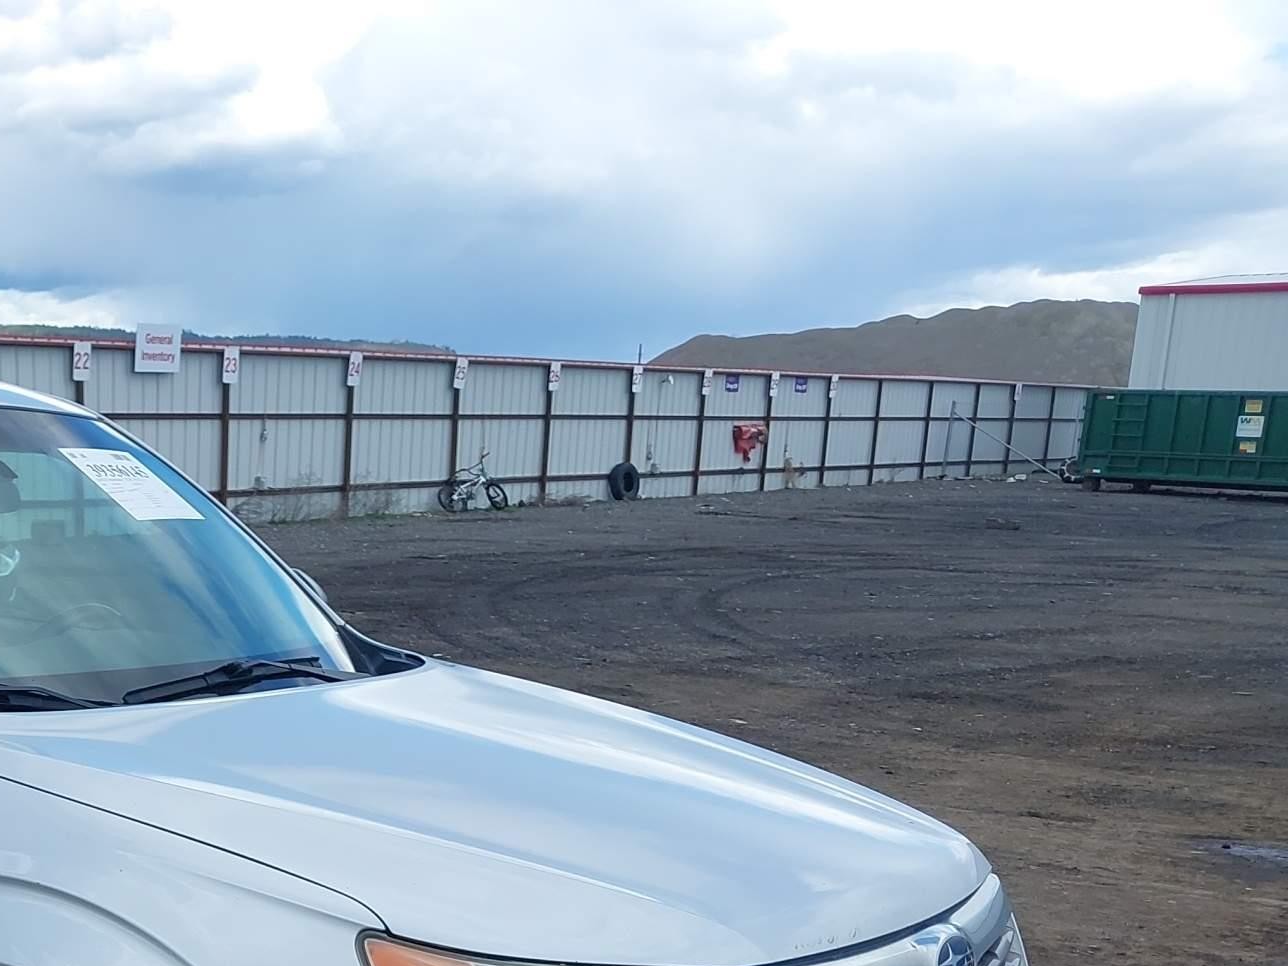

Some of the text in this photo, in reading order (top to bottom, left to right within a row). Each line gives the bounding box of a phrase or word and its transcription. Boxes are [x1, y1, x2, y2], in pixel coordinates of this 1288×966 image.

[144, 333, 173, 345] General
[74, 352, 90, 370] 22
[141, 350, 175, 364] Inventory
[224, 357, 238, 374] 23
[349, 361, 361, 377] 24
[86, 464, 150, 479] 39356145
